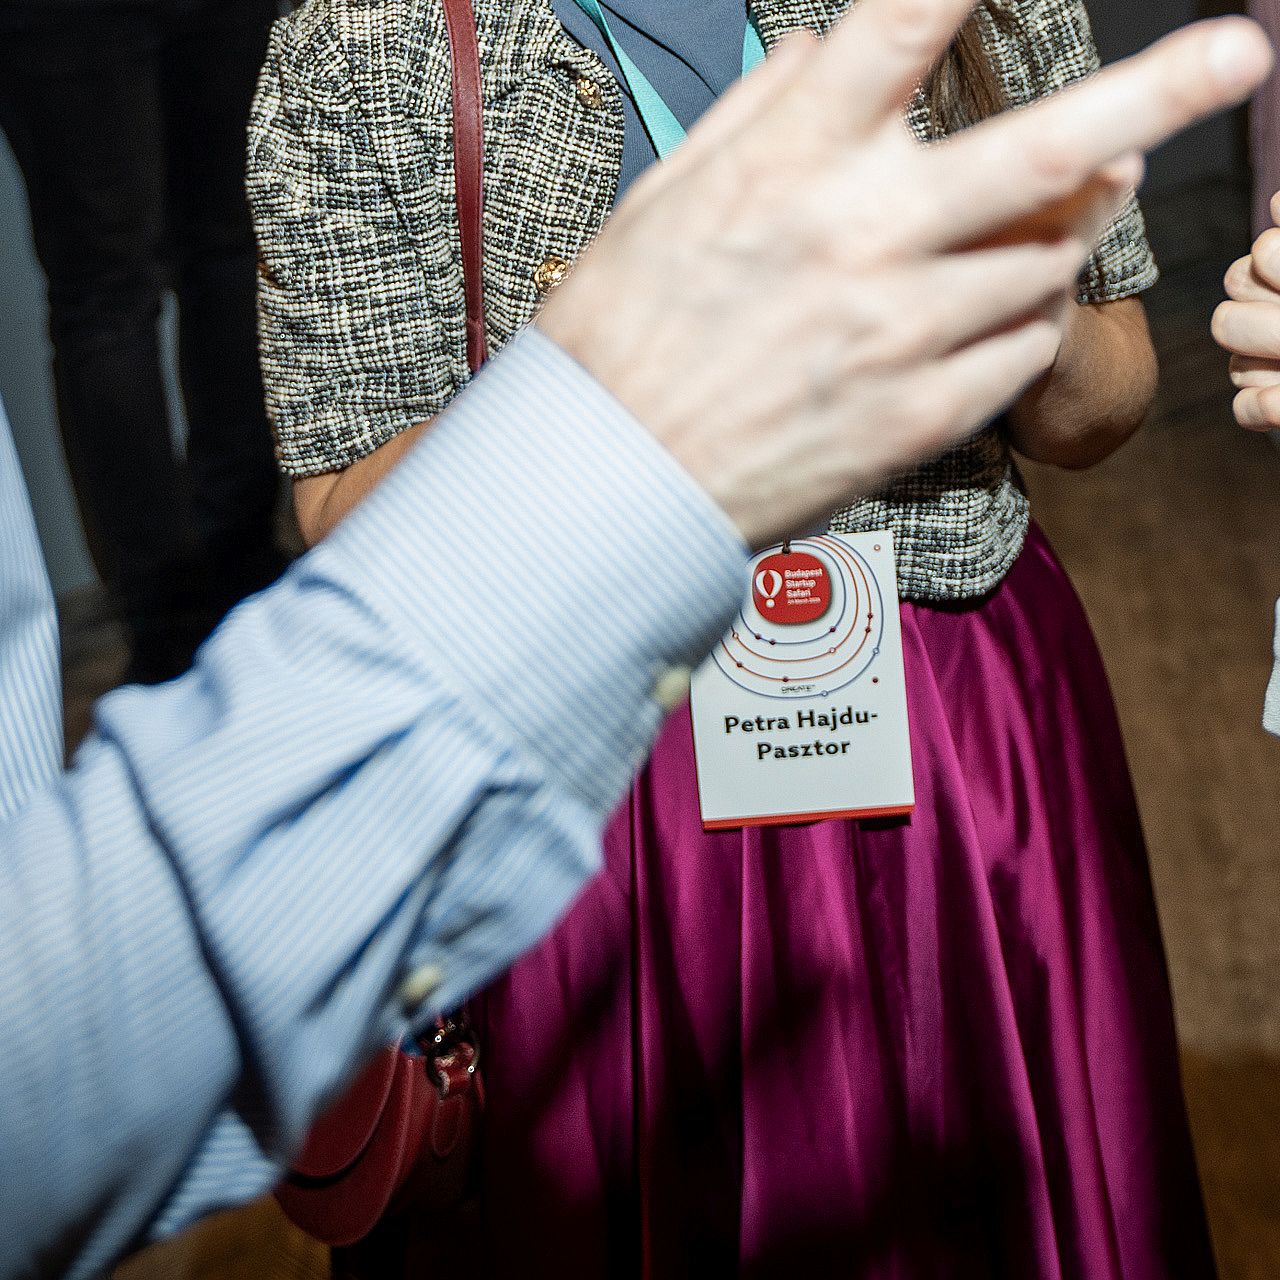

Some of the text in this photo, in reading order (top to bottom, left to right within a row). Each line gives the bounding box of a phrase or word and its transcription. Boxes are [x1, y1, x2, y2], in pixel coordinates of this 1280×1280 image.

[785, 579, 816, 589] Startup
[724, 705, 878, 734] Petra Hajdu-
[757, 739, 851, 760] Pasztor
